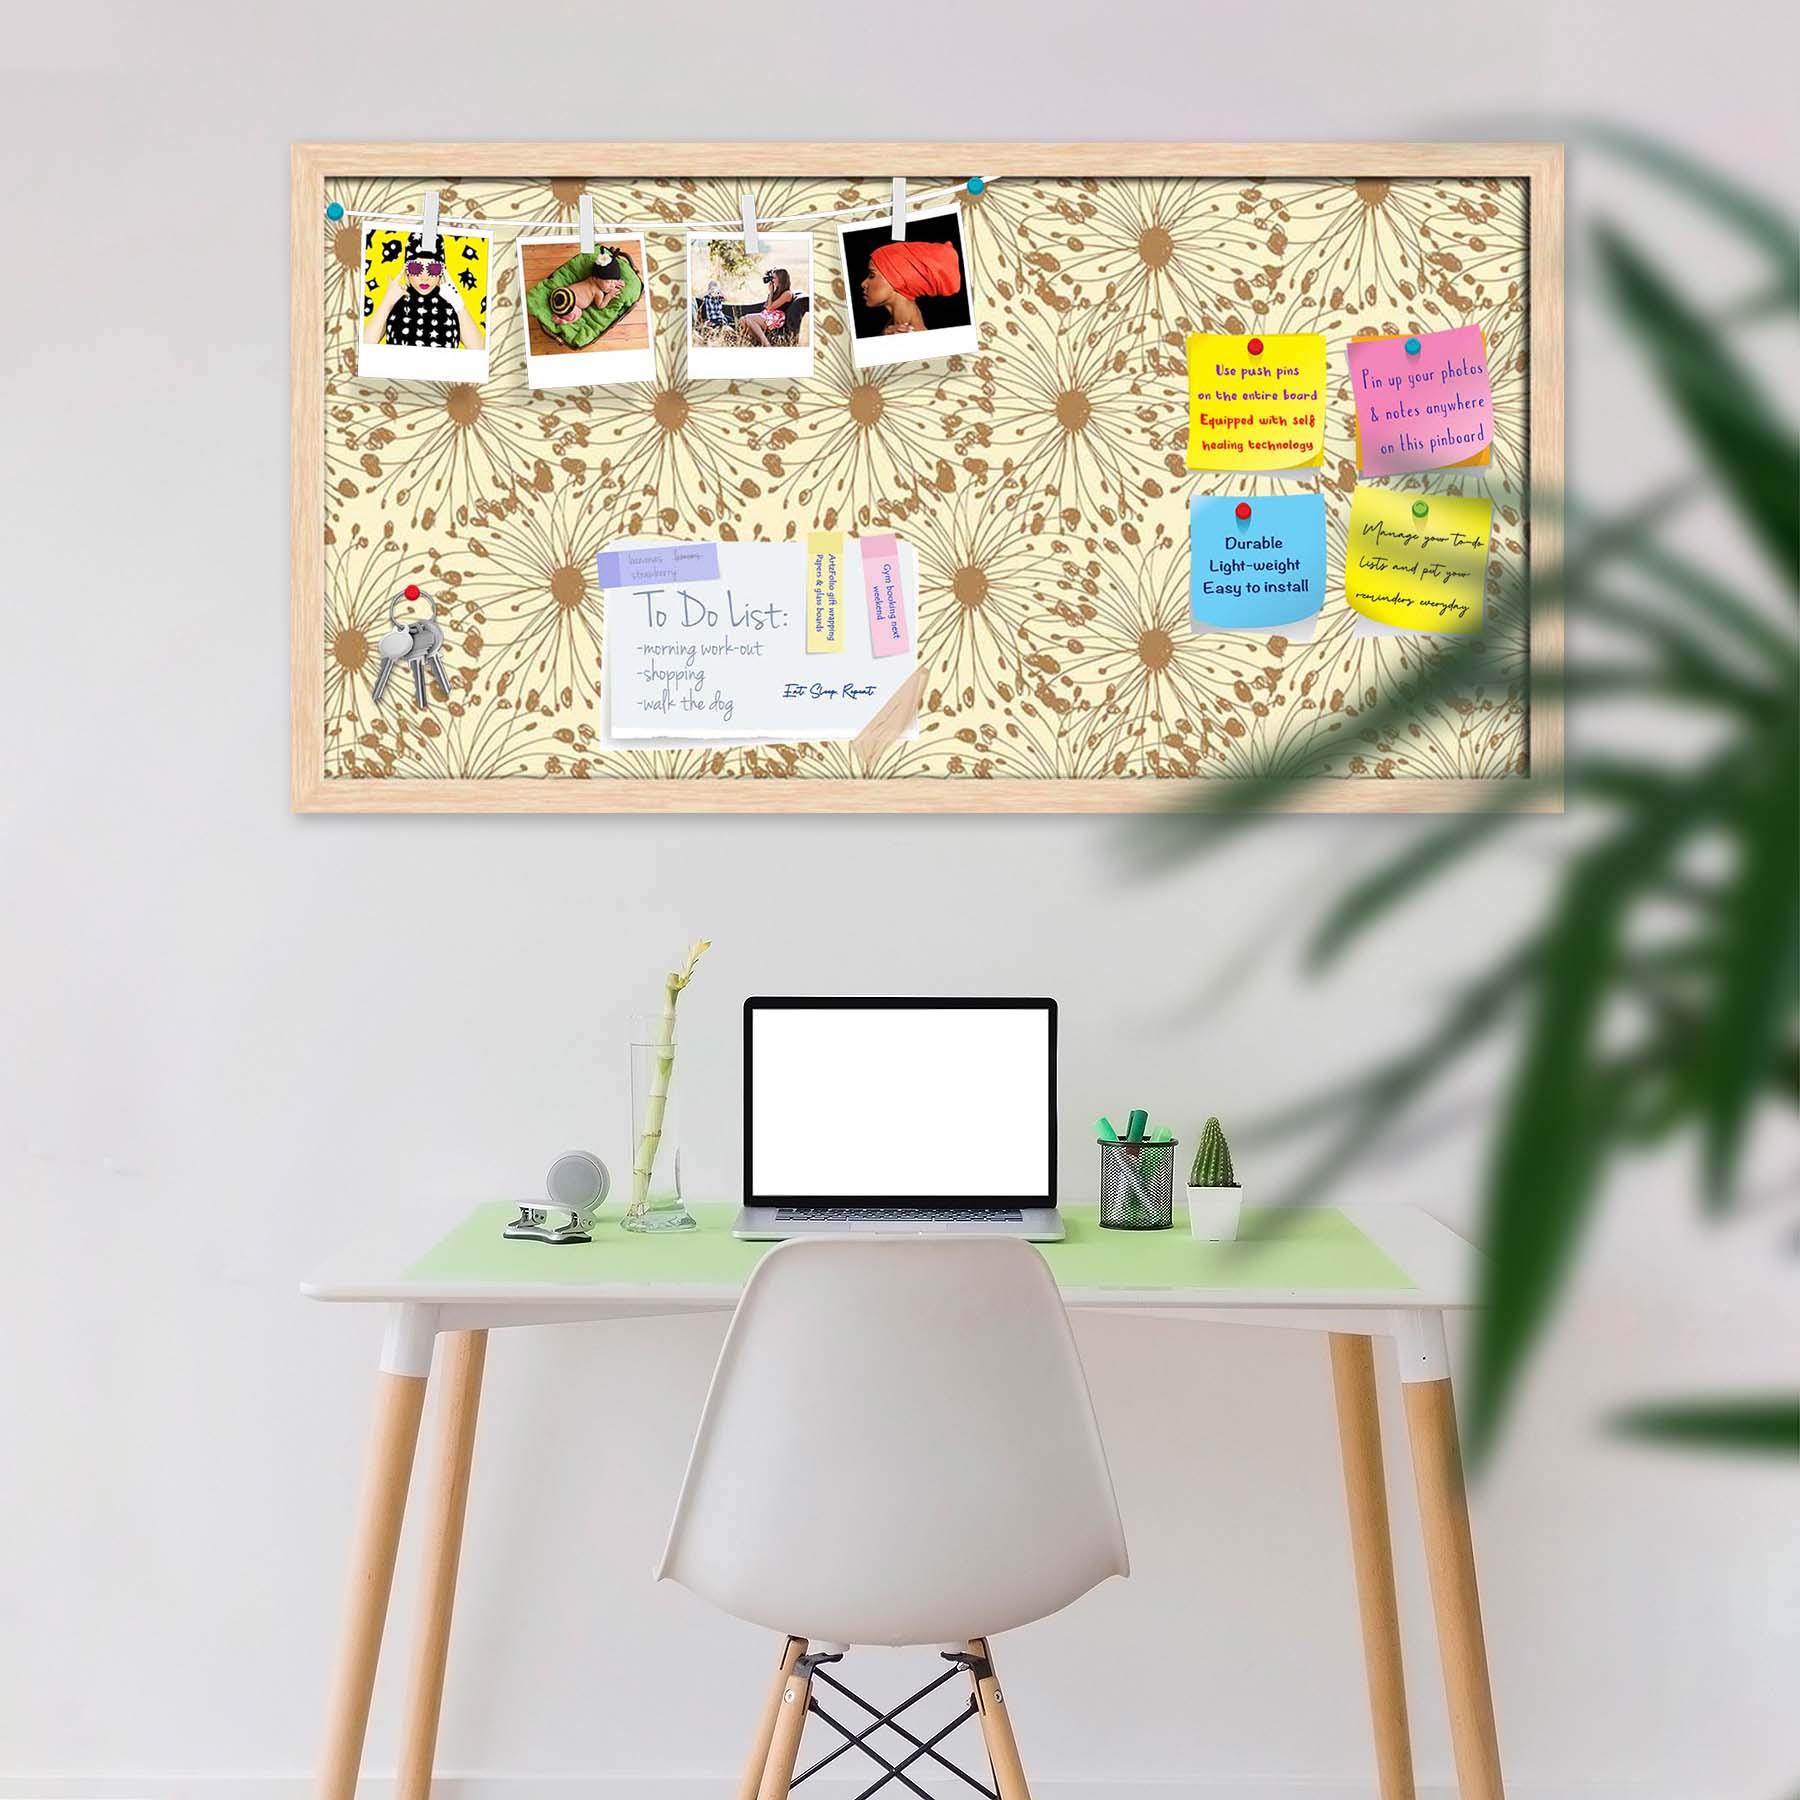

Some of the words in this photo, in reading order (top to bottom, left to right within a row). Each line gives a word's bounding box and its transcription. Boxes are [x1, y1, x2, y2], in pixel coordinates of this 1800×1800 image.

[1216, 364, 1236, 376] Use
[1241, 366, 1271, 380] push
[1277, 366, 1299, 380] pins
[1362, 368, 1382, 389] Pin
[1388, 375, 1402, 390] up
[1408, 371, 1434, 389] your
[1441, 358, 1483, 384] photos
[1198, 392, 1211, 400] on
[1216, 390, 1237, 401] the
[1243, 390, 1278, 400] entire
[1283, 389, 1318, 400] board
[1370, 406, 1379, 422] &
[1386, 400, 1420, 420] notes
[1426, 392, 1484, 418] anywhere
[1200, 413, 1254, 429] Equipped
[1259, 414, 1287, 426] with
[1293, 414, 1315, 428] self
[1202, 440, 1244, 453] healing
[1248, 440, 1313, 453] technology
[1380, 444, 1394, 454] on
[1400, 433, 1424, 451] this
[1430, 423, 1484, 453] pinboard
[1225, 536, 1283, 550] Durable
[1362, 520, 1419, 545] Manage
[1422, 535, 1449, 548] your
[882, 563, 892, 584] Gym
[1210, 557, 1300, 575] Light-weight
[1392, 562, 1419, 574] and
[1420, 563, 1446, 581] put
[1443, 571, 1471, 584] your
[814, 588, 825, 606] glass
[827, 592, 837, 606] gift
[1203, 581, 1241, 597] Easy
[1246, 582, 1260, 593] to
[1264, 579, 1309, 593] install
[632, 590, 666, 627] To
[677, 590, 718, 627] Do
[727, 590, 788, 630] List:
[873, 585, 885, 620] weekend
[886, 585, 897, 619] booking
[1355, 592, 1416, 606] reminders
[1420, 599, 1470, 618] everyday
[816, 607, 824, 632] boards
[827, 607, 836, 641] wrapping
[891, 621, 901, 639] next
[701, 634, 765, 656] work-out
[782, 683, 808, 698] Eat
[842, 683, 877, 700] Repeat
[680, 688, 705, 711] the
[709, 690, 734, 722] dog
